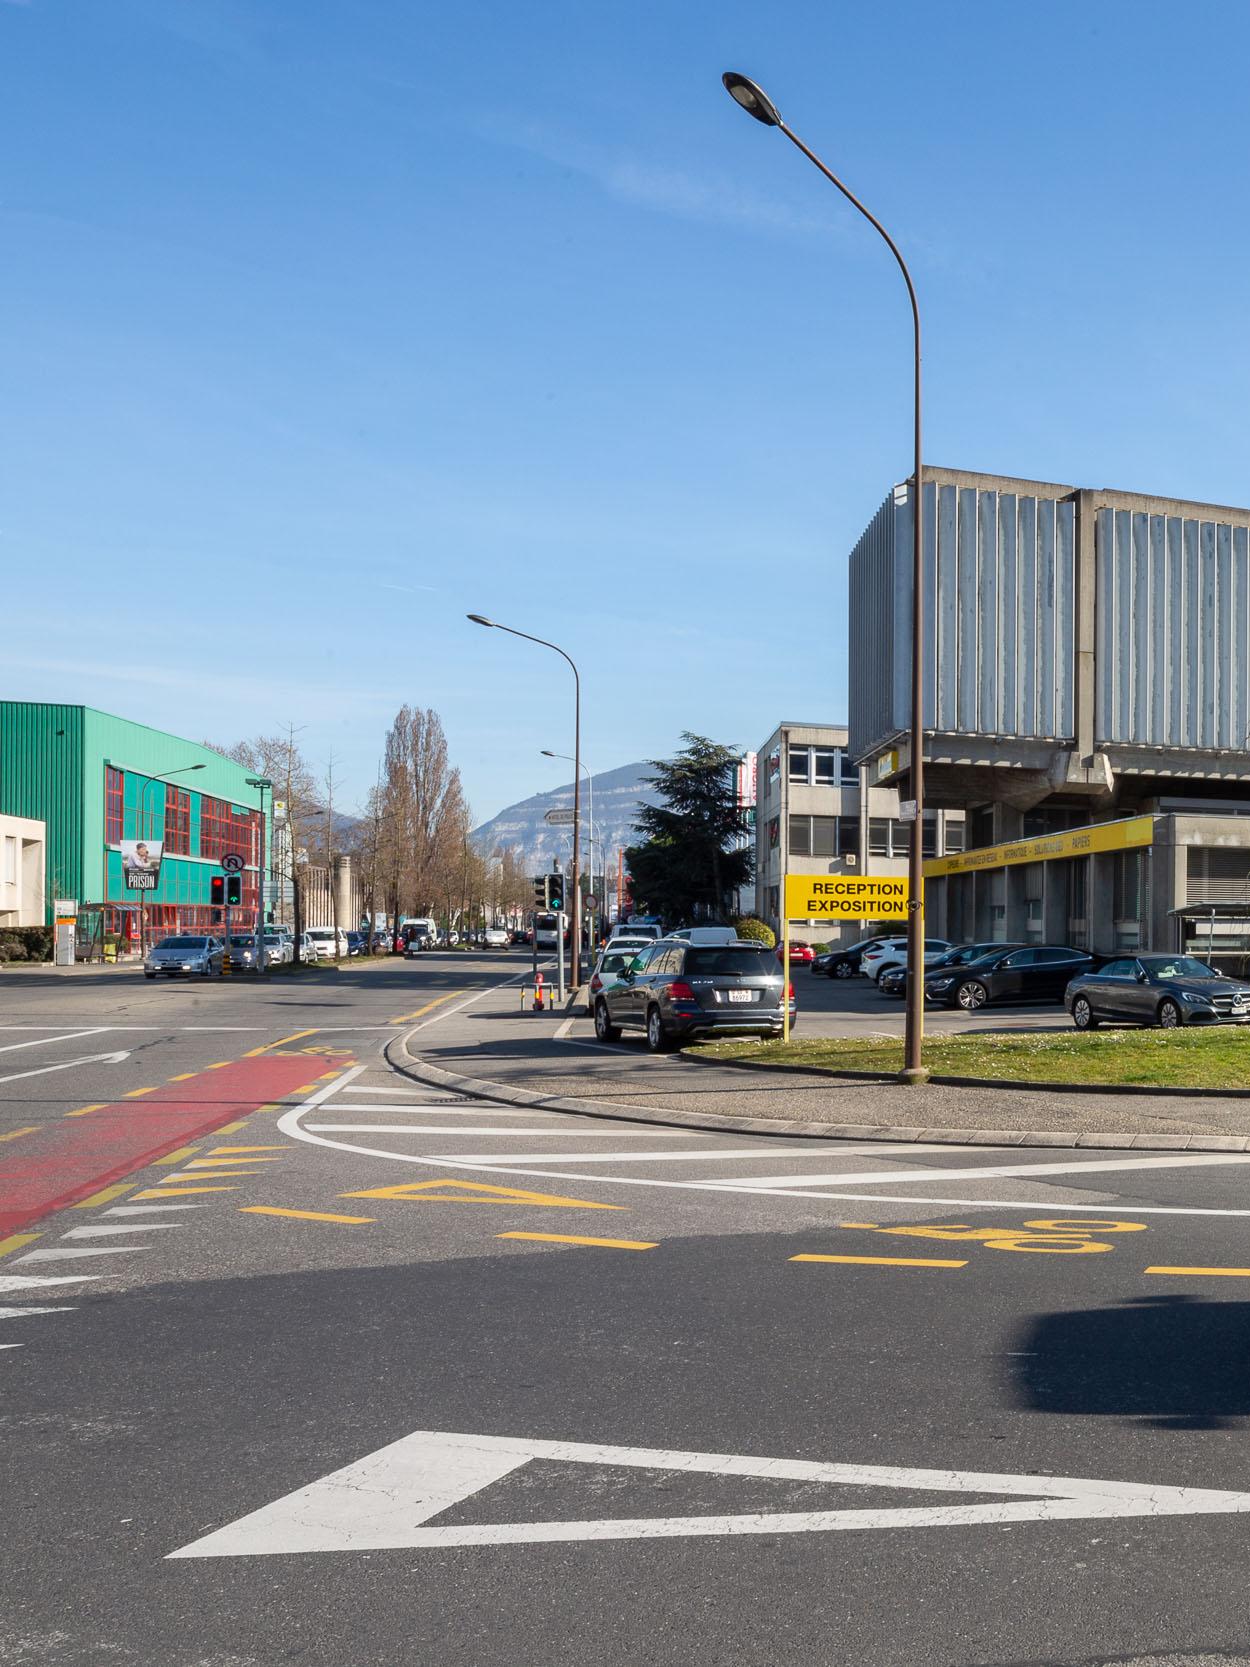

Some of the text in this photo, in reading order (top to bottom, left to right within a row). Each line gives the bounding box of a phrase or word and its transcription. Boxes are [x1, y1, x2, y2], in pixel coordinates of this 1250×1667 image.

[1072, 834, 1090, 849] PAPIERS
[128, 875, 155, 888] PRISON
[812, 883, 904, 895] RECEPTION
[807, 900, 904, 912] EXPOSITION
